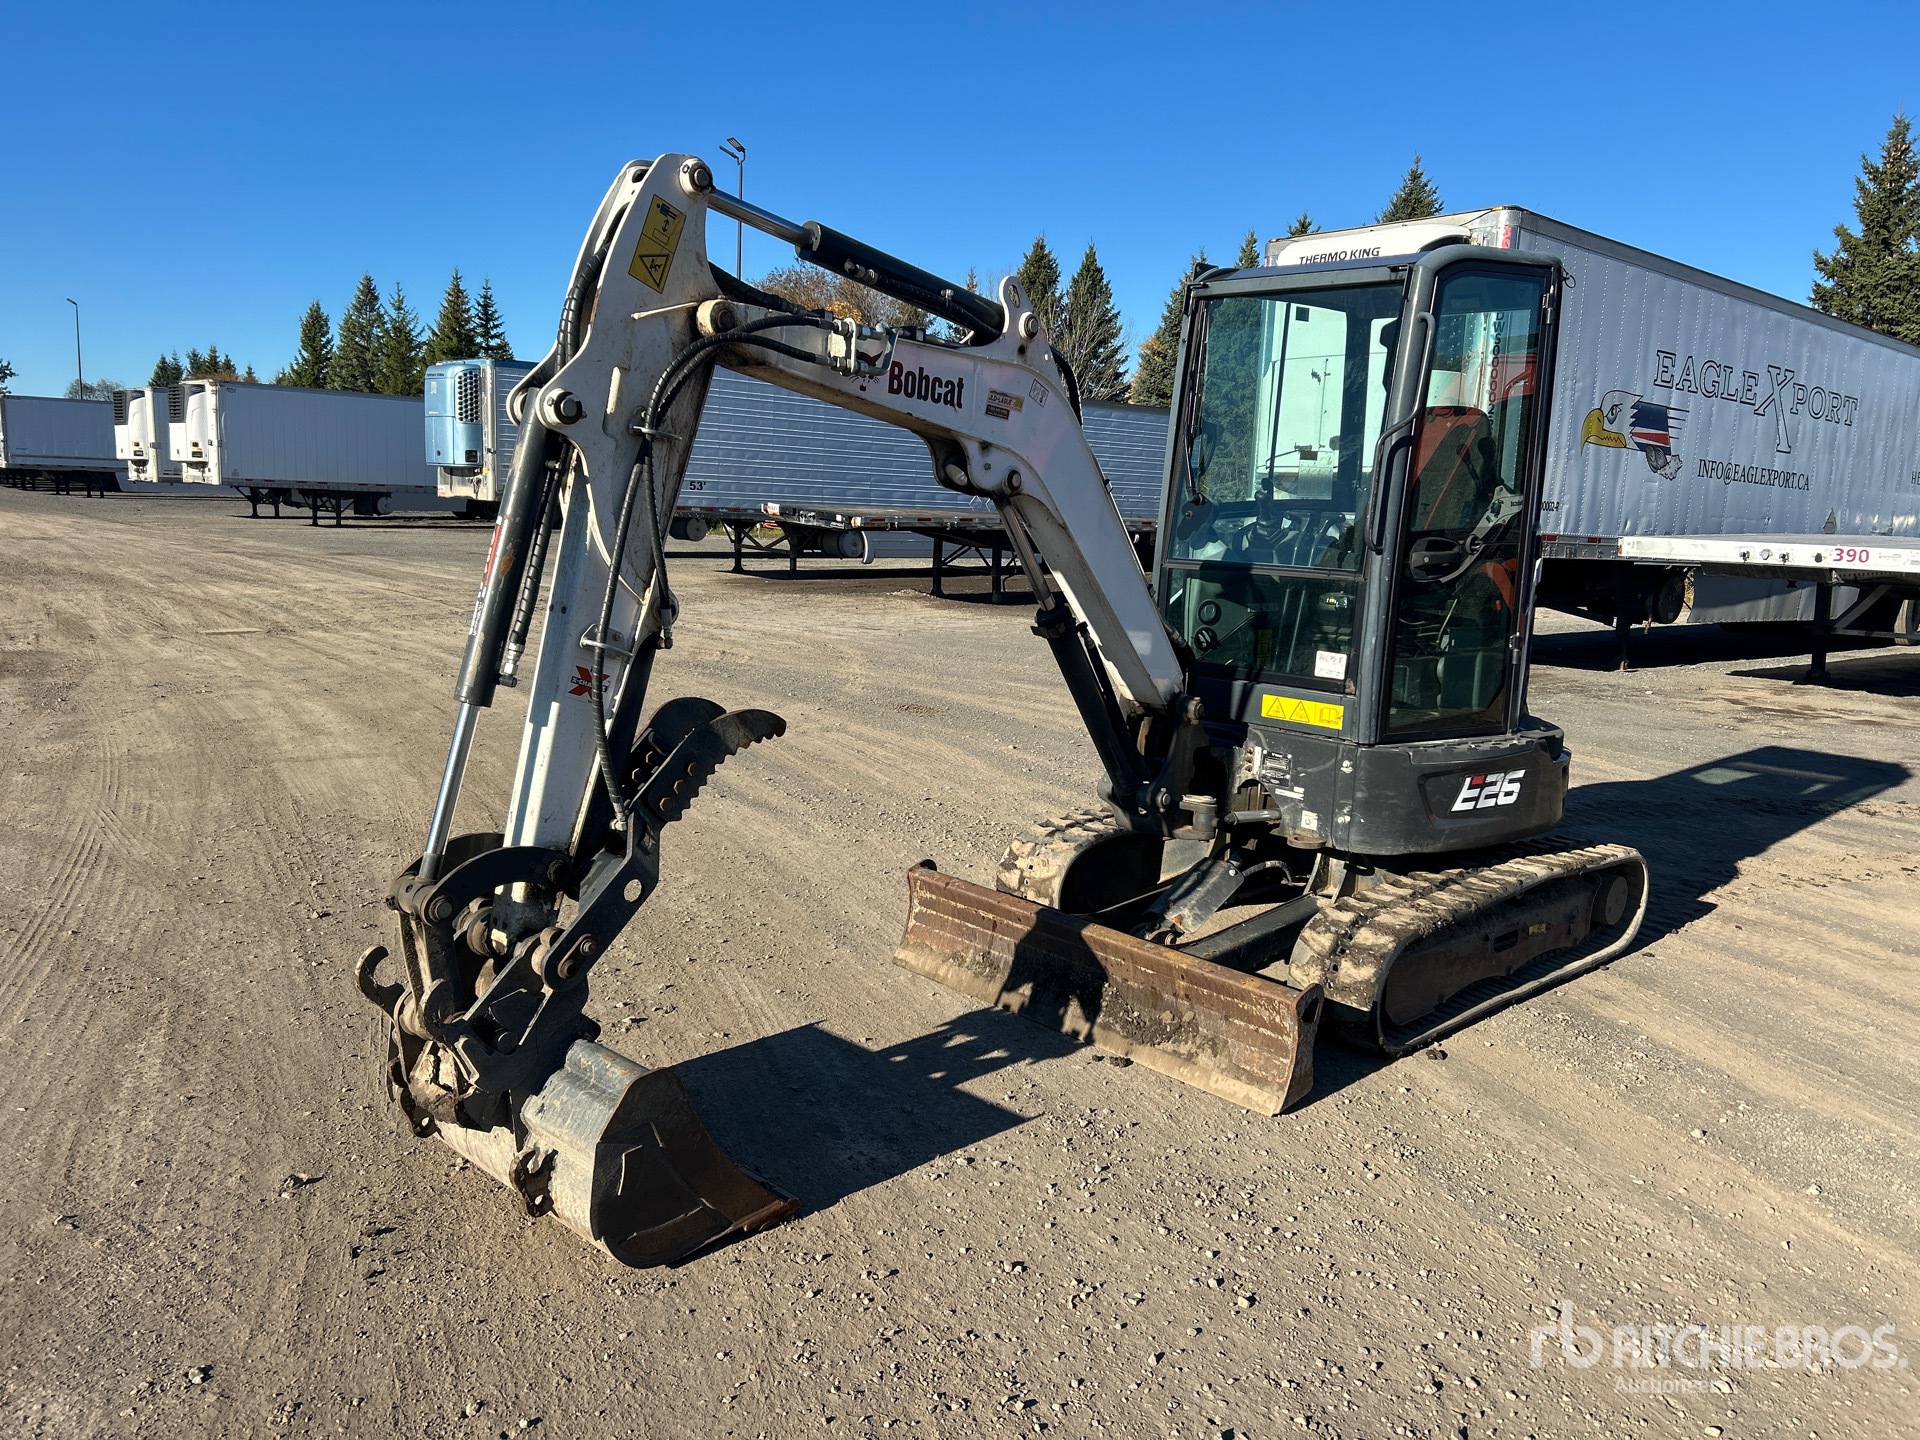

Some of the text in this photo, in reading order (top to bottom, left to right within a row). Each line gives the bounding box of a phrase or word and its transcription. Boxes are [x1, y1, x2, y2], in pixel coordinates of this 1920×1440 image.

[1299, 247, 1381, 265] THERMO KING
[888, 361, 964, 410] Bobcat
[1697, 458, 1810, 491] INFO@EAGLEXPORT.CA
[689, 480, 706, 491] 53'
[1833, 548, 1870, 563] 390
[571, 676, 608, 693] X-CHAE
[1451, 769, 1526, 811] E26
